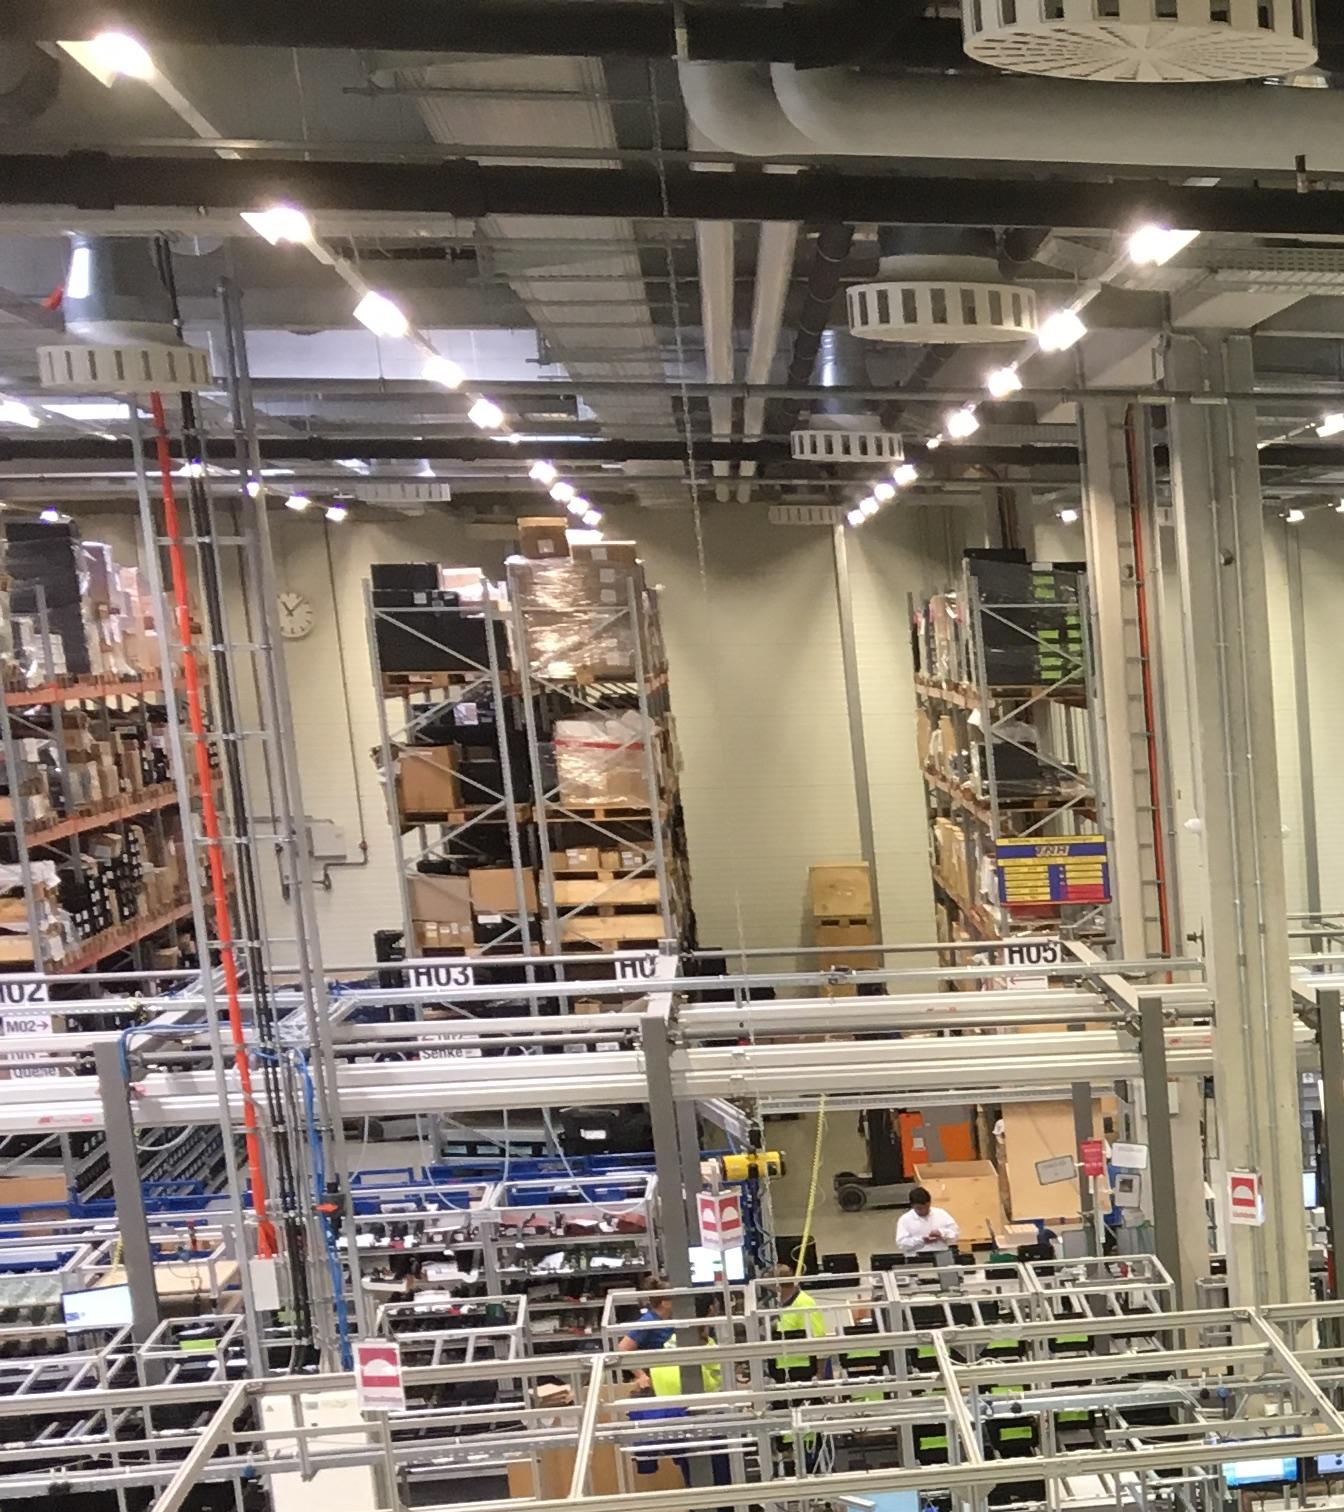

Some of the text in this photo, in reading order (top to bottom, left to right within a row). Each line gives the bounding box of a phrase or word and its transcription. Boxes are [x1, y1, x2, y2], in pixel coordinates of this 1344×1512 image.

[1008, 944, 1057, 964] H05
[414, 966, 471, 987] H03
[0, 983, 45, 1004] 02
[6, 1020, 36, 1033] M02
